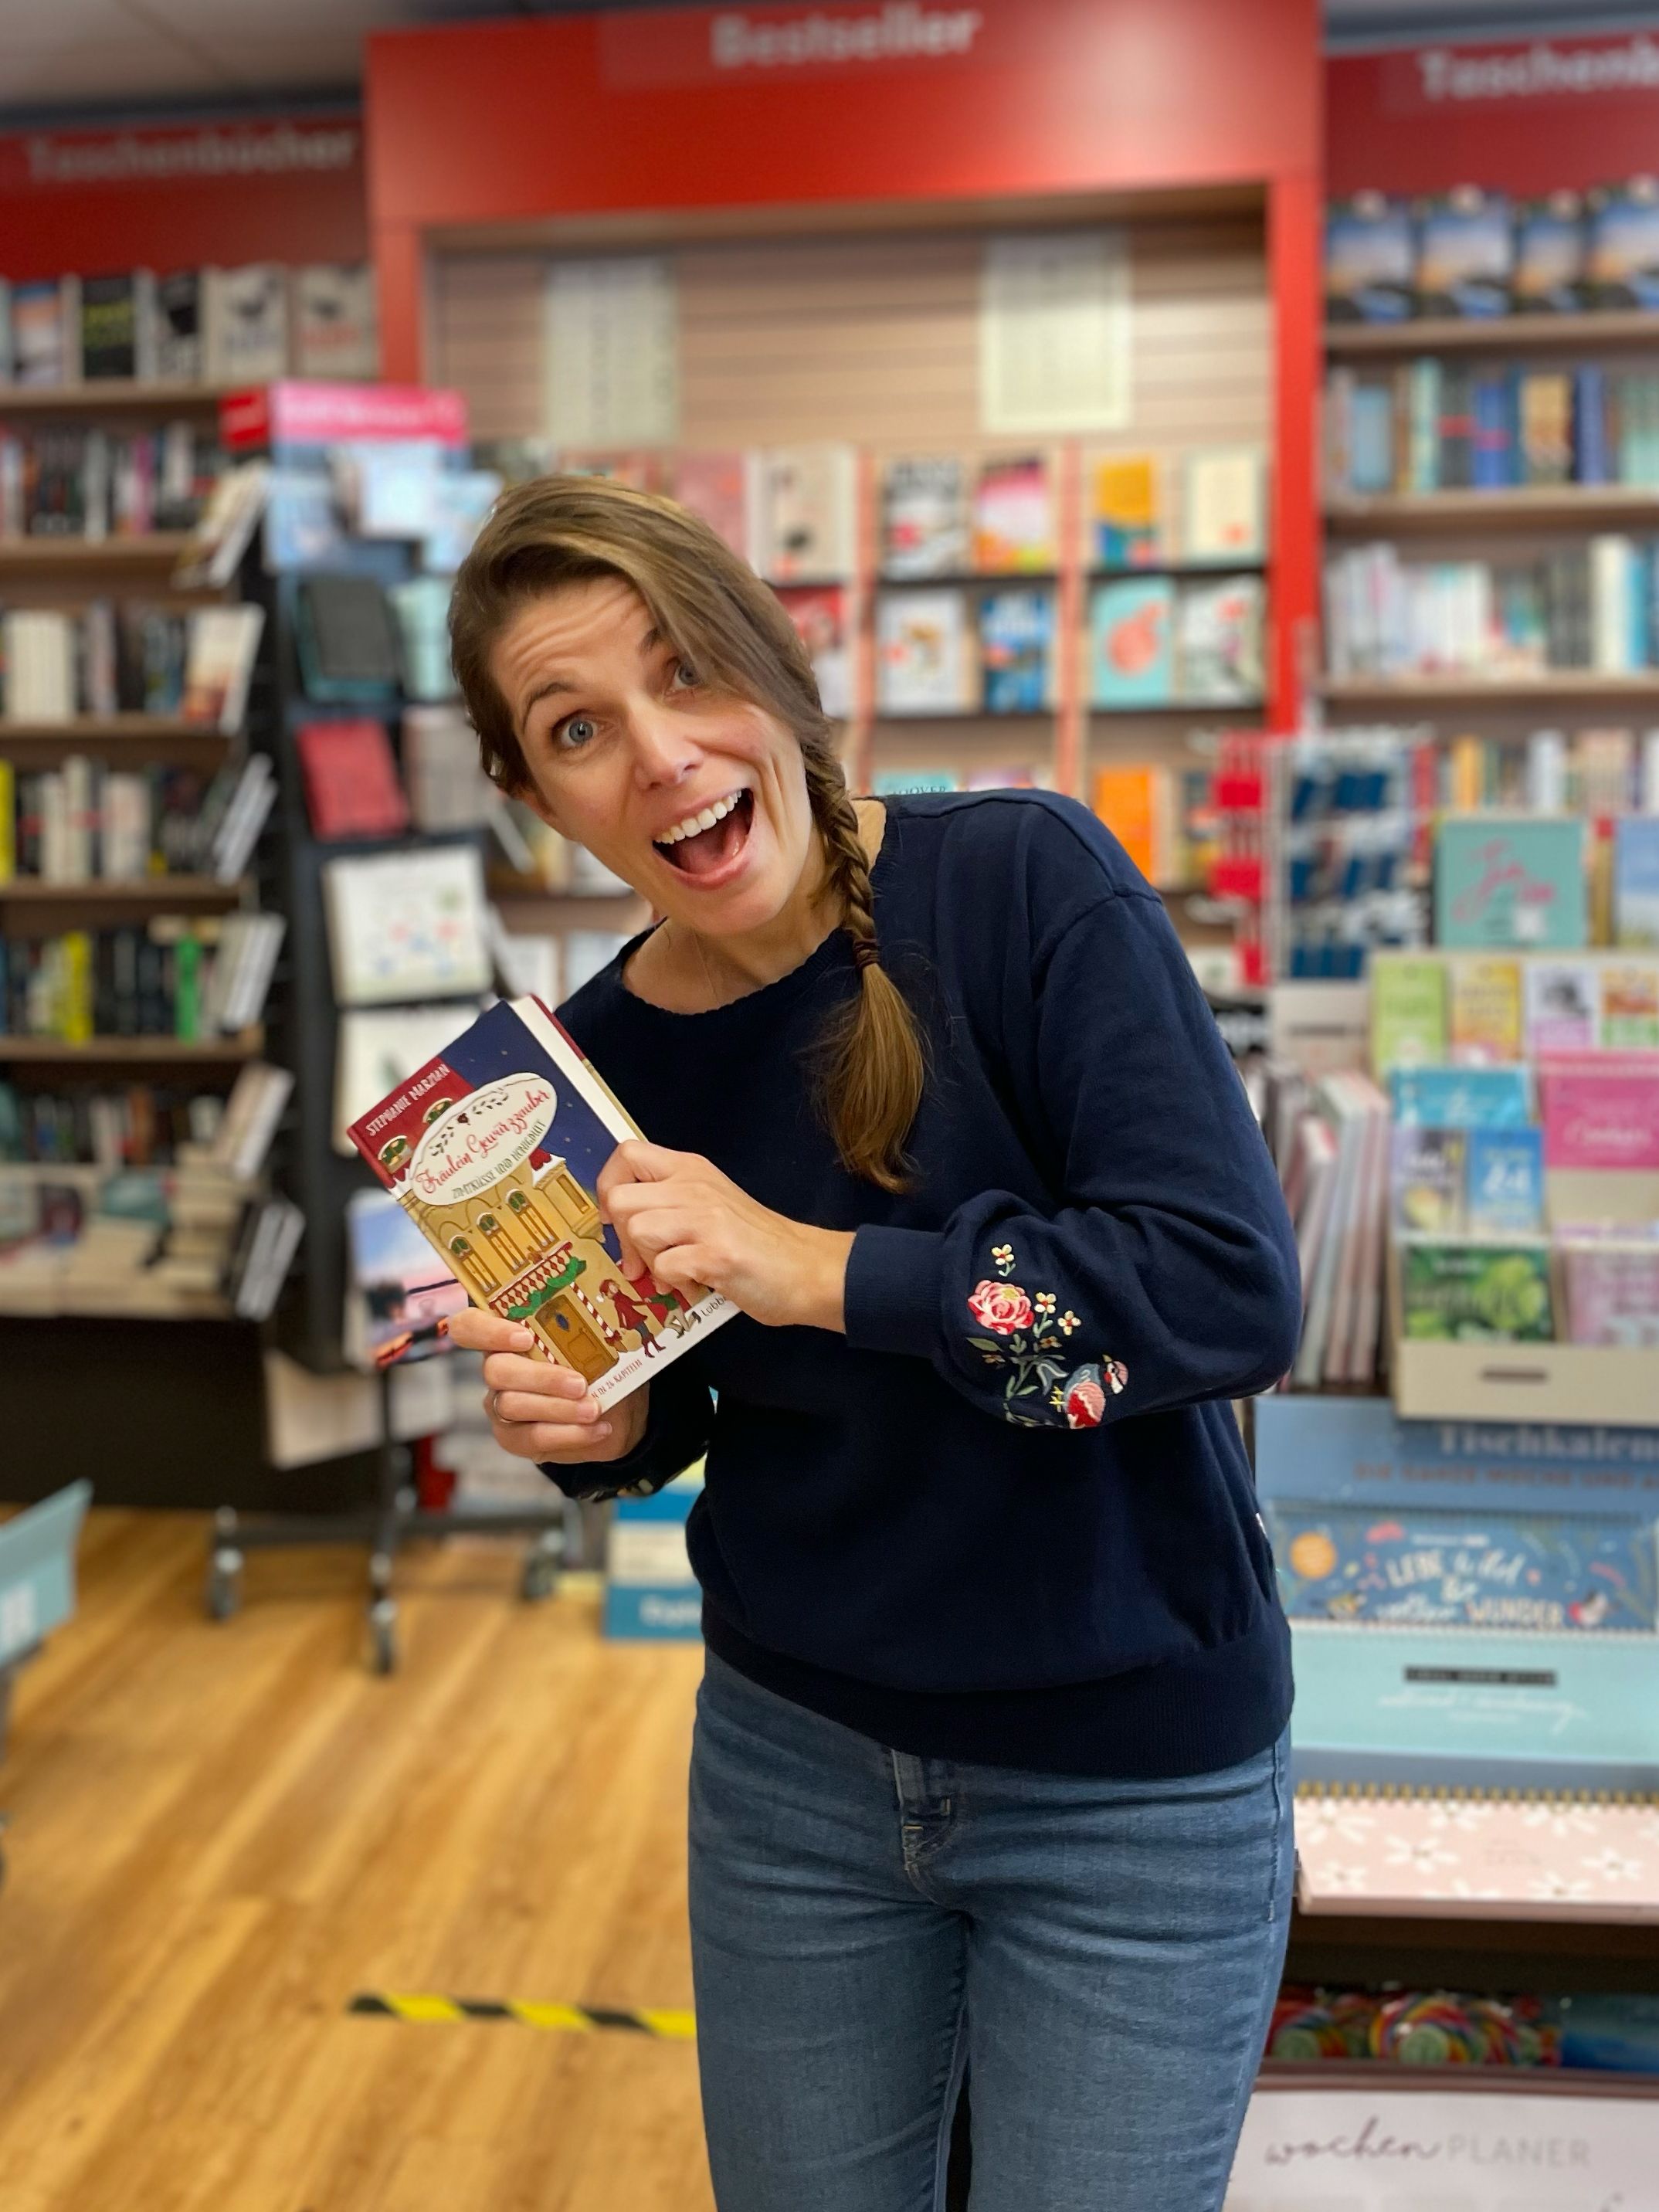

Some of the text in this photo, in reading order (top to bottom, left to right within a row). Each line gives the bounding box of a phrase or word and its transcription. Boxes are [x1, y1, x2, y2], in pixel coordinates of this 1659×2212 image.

[711, 2, 982, 68] Bestseller
[365, 1064, 450, 1137] STEPHANIE MARZIAN
[415, 1090, 551, 1194] Fräulein Gewürzzauber
[498, 1157, 514, 1176] UND
